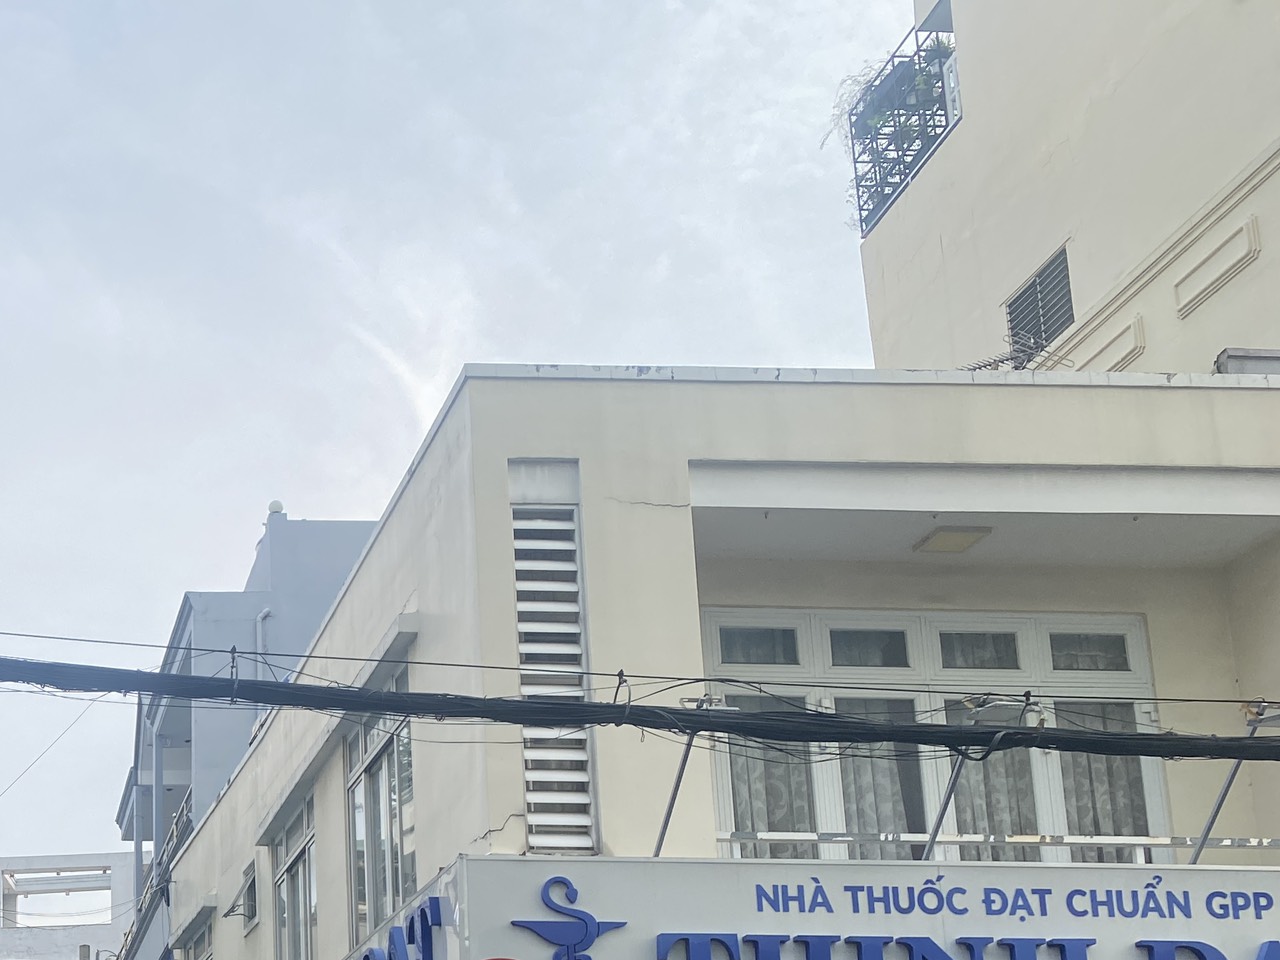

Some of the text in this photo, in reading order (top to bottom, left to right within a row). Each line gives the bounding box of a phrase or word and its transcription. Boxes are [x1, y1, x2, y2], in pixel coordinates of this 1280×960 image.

[755, 875, 1274, 923] NHÀ THUỐC ĐẠT CHUẨN GPP
